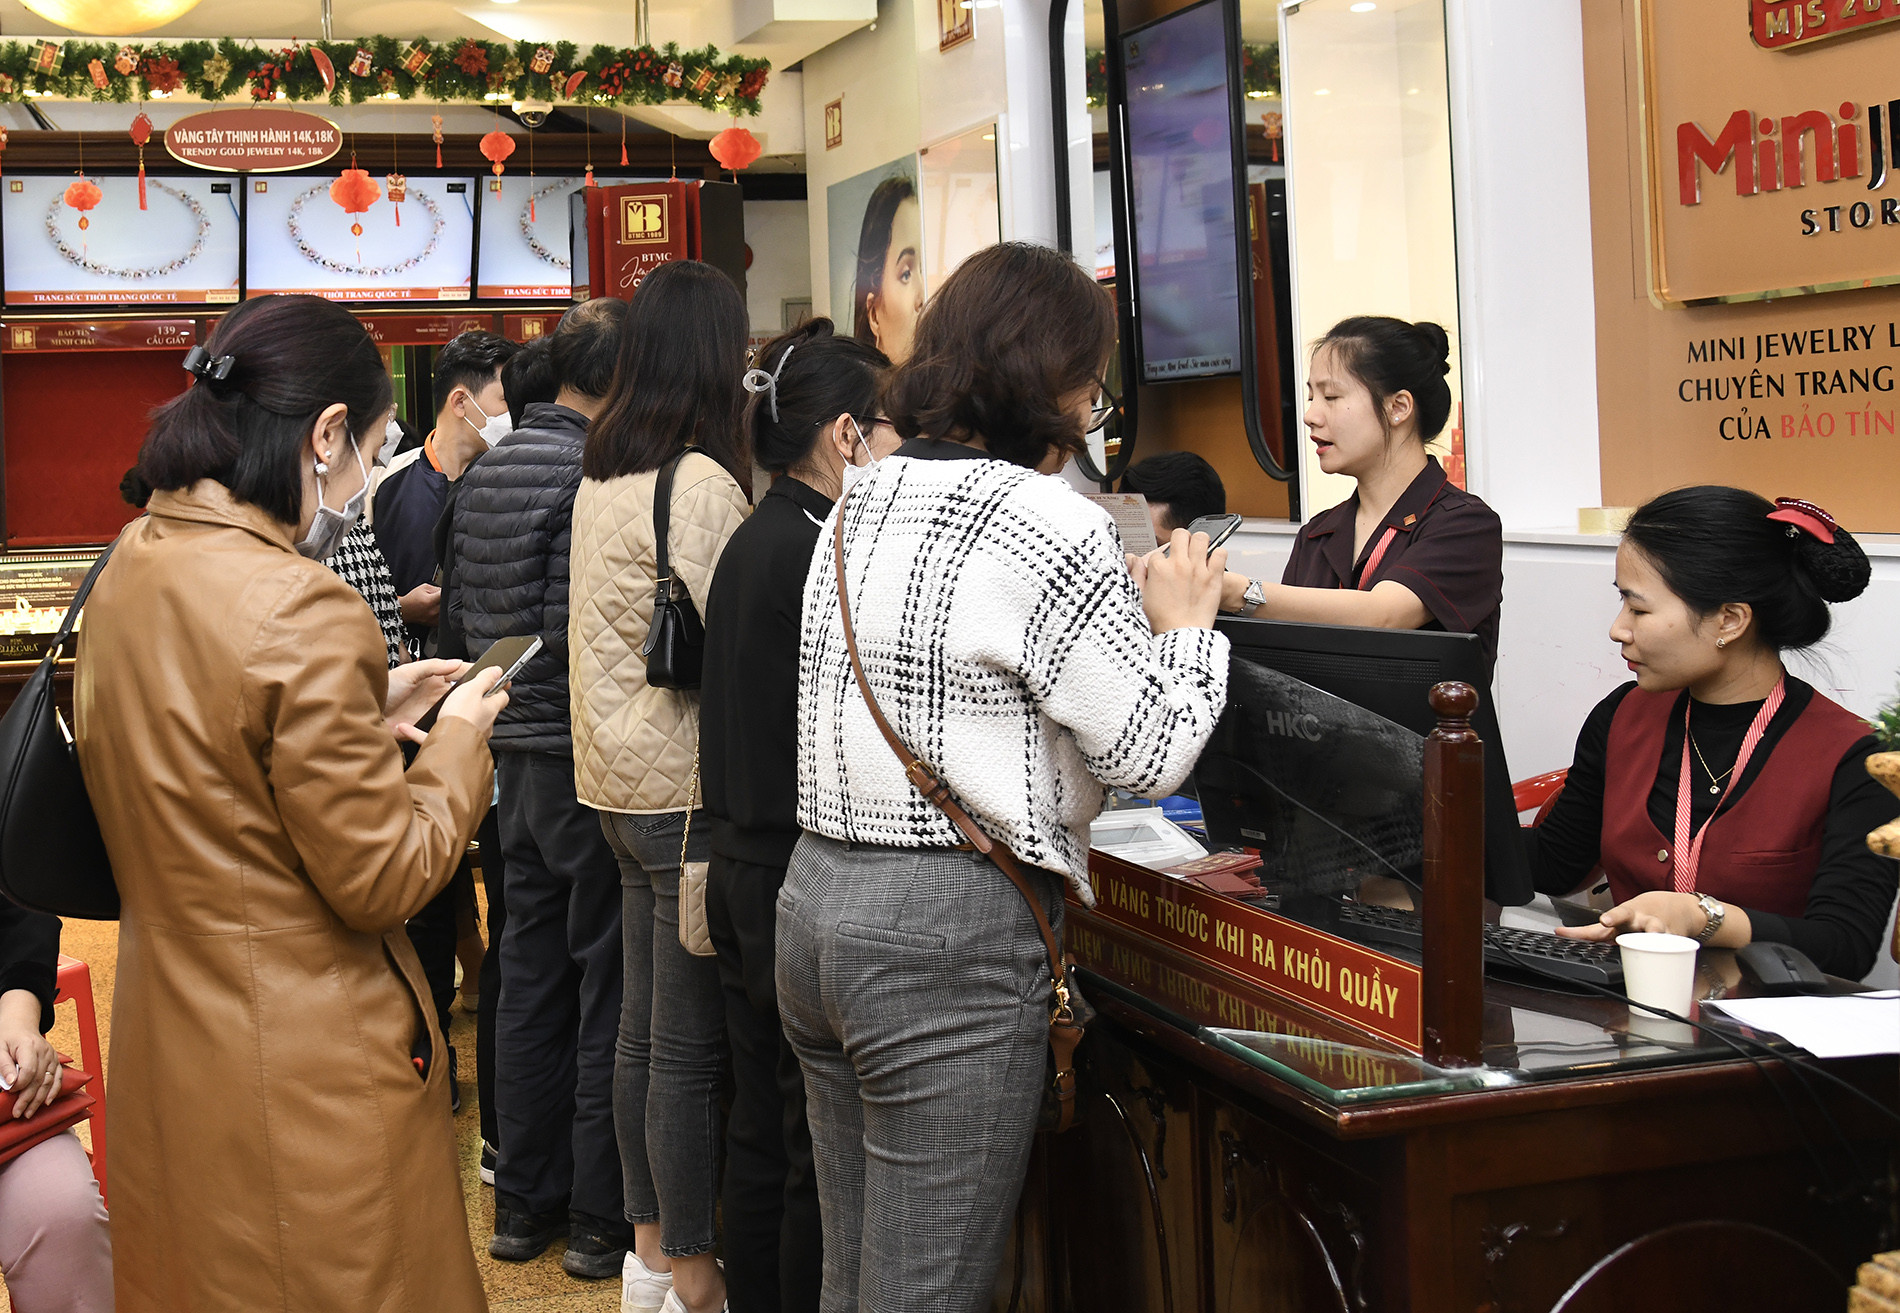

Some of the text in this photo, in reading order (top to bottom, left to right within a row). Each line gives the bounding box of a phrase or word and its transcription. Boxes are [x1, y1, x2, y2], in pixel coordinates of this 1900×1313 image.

[174, 128, 204, 144] VÀNG
[205, 128, 225, 144] TÂY
[226, 130, 259, 146] THỊNH
[260, 128, 291, 143] HÀNH
[181, 147, 218, 157] TRENDY
[219, 147, 245, 157] GOLD
[247, 147, 284, 157] JEWELRY
[308, 147, 323, 156] 18K
[641, 252, 672, 263] BTMC
[34, 293, 63, 302] TRANG
[108, 293, 138, 302] TRANG
[345, 291, 374, 299] TRANG
[503, 288, 531, 296] TRANG
[157, 325, 176, 335] 139
[1687, 336, 1745, 364] MINI
[1755, 324, 1876, 364] JEWELRY
[1678, 365, 1895, 402] CHUYÊN TRANG
[1719, 401, 1895, 441] CỦA BẢO TÍN
[1266, 710, 1321, 741] HKC
[1110, 876, 1149, 919] VÀNG
[1155, 896, 1209, 943] TRƯỚC
[1215, 919, 1244, 958] KHI
[1252, 933, 1276, 971] RA
[1284, 948, 1330, 993] KHỎI
[1340, 964, 1399, 1019] QUẦY
